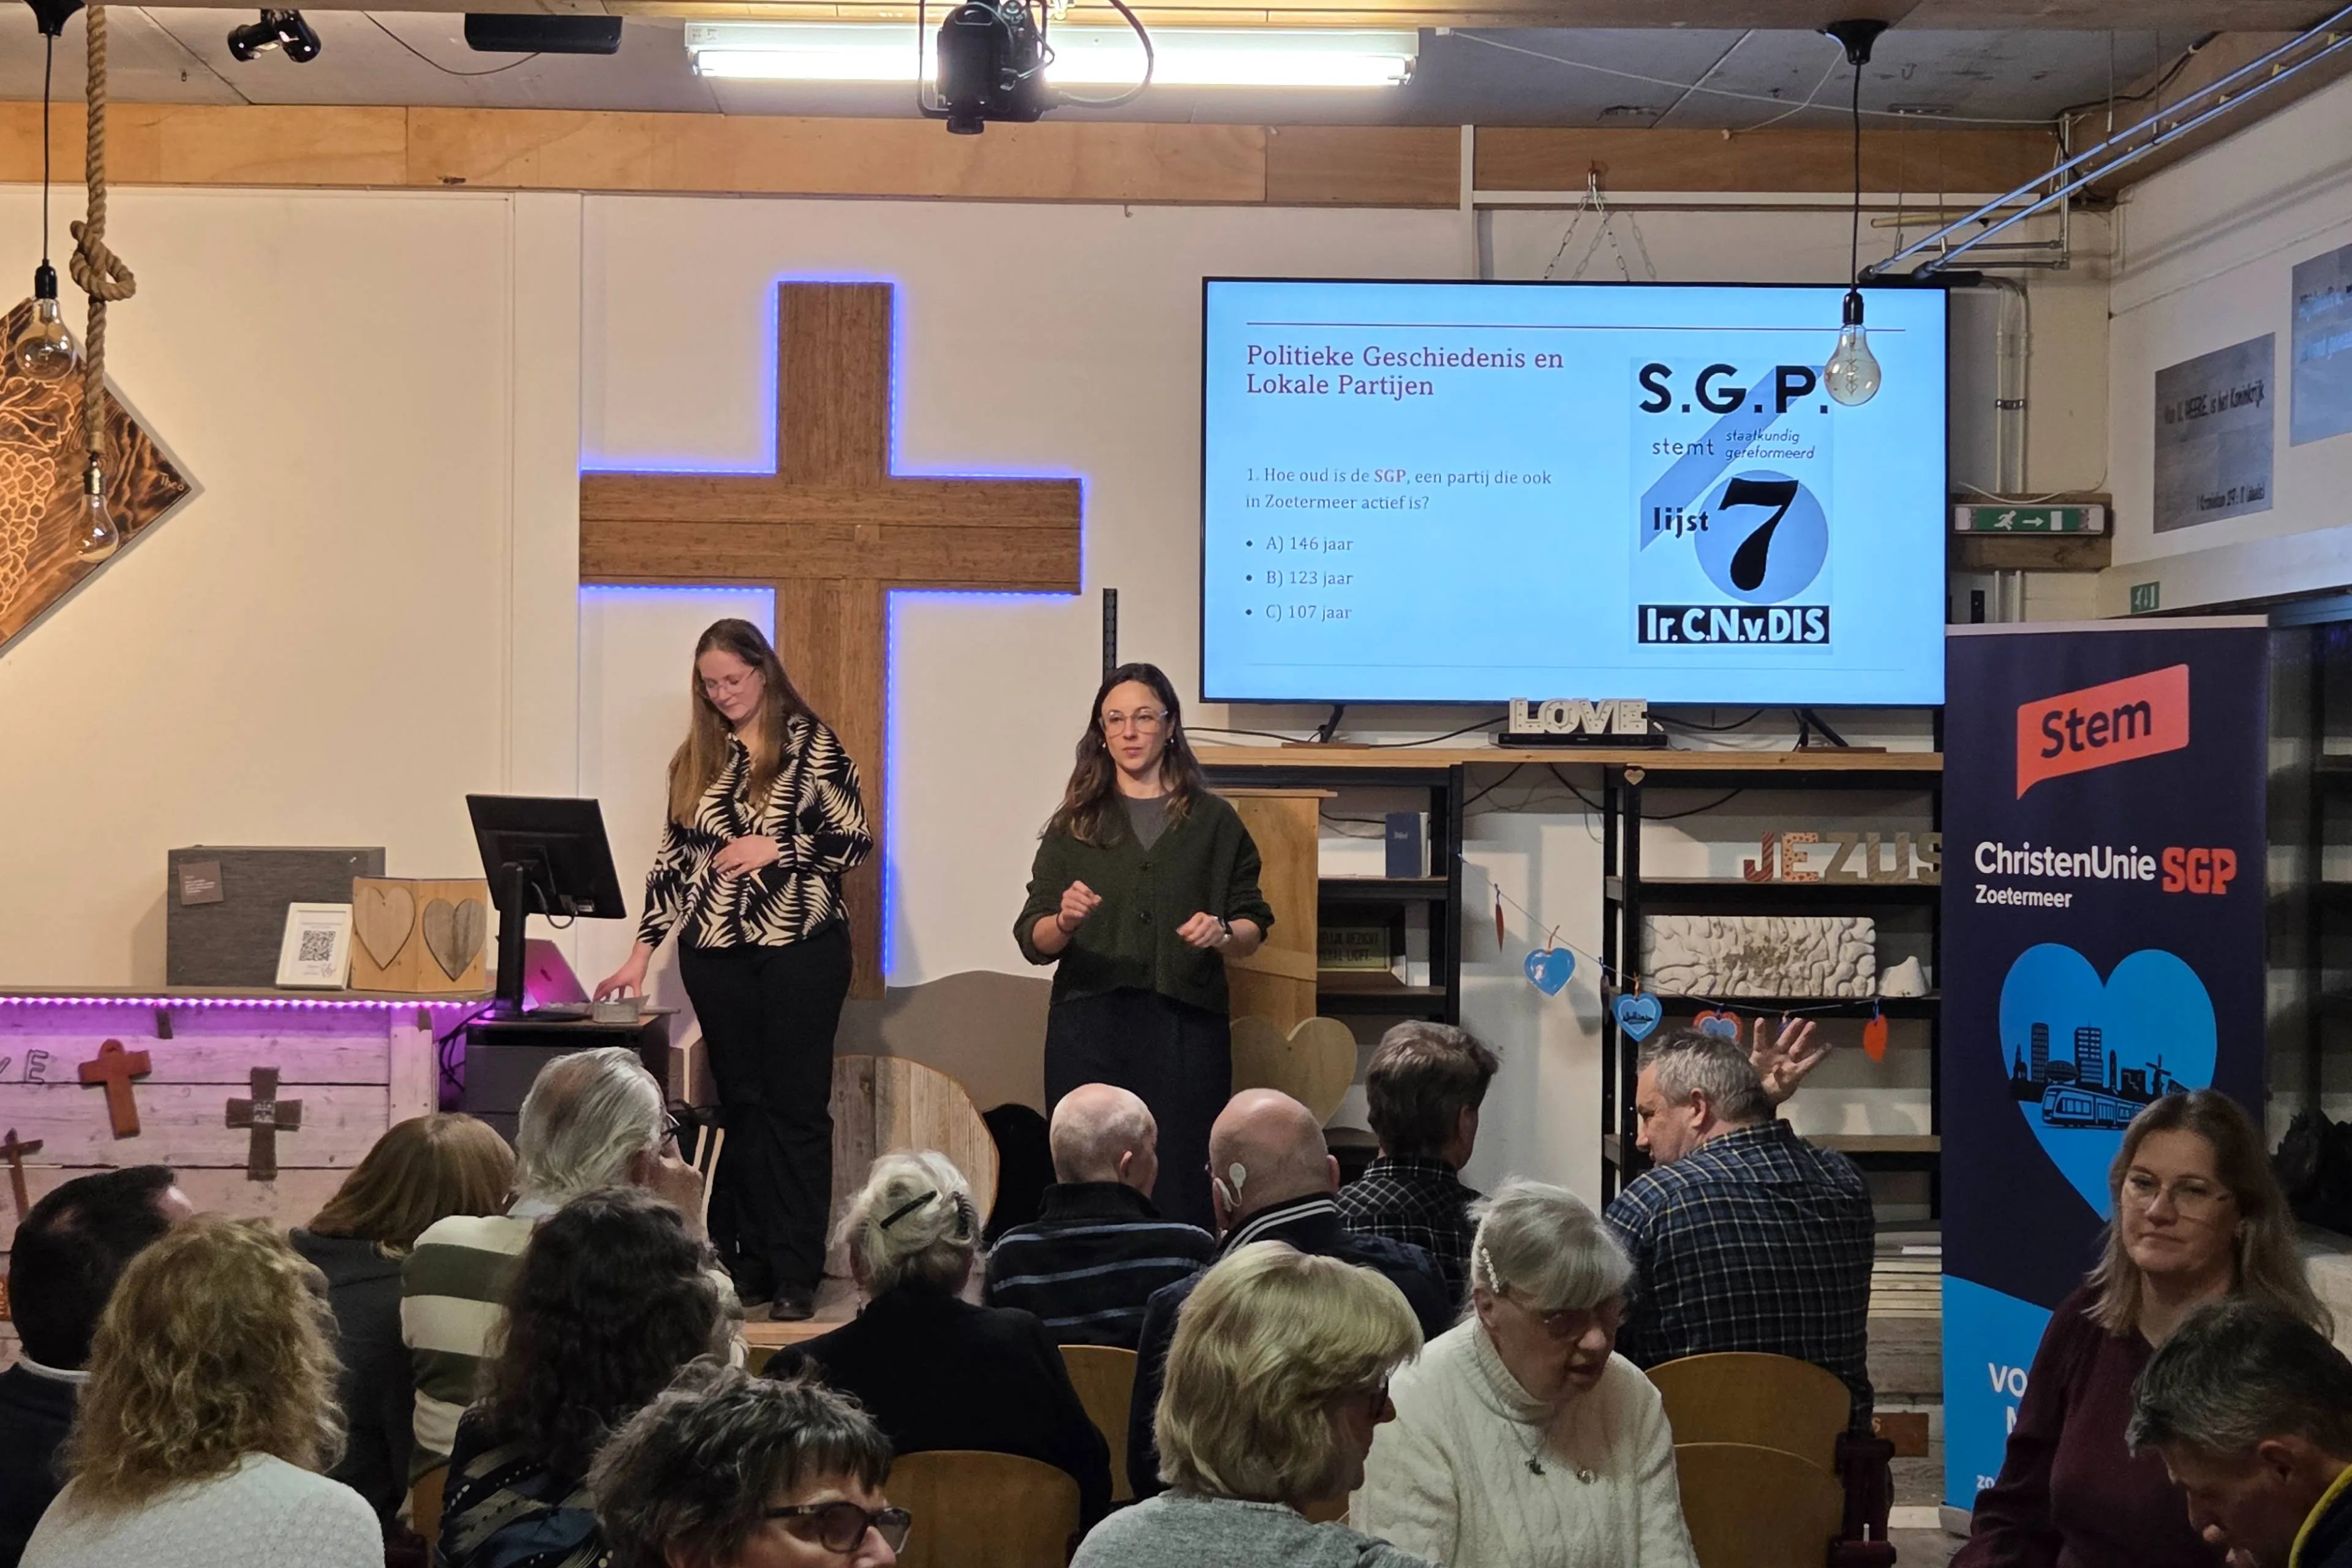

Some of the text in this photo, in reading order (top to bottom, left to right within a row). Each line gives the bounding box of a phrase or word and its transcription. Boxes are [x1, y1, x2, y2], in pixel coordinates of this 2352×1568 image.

[1247, 344, 1564, 368] Politieke Geschiedenis en
[1246, 373, 1434, 401] Lokale Partijen
[1638, 363, 1828, 414] S.G.P.
[1652, 437, 1715, 456] stemt
[1725, 428, 1800, 445] staatkundig
[1725, 445, 1816, 461] gereformeerd
[1247, 467, 1552, 488] 1. Hoe oud is de SGP, een partij die ook
[1246, 494, 1430, 510] in Zoetermeer actief is?
[1653, 507, 1709, 539] lijst
[1717, 477, 1800, 591] 7
[1265, 535, 1354, 554] A) 146 jaar
[1265, 570, 1354, 589] B) 123 jaar
[1265, 604, 1353, 623] C) 107 jaar
[1509, 697, 1648, 734] LOVE
[2040, 699, 2152, 760] Stem
[1743, 831, 1943, 883] JEZUS
[1974, 841, 2237, 895] ChristenUnie SGP
[1975, 884, 2073, 908] Zoetermeer
